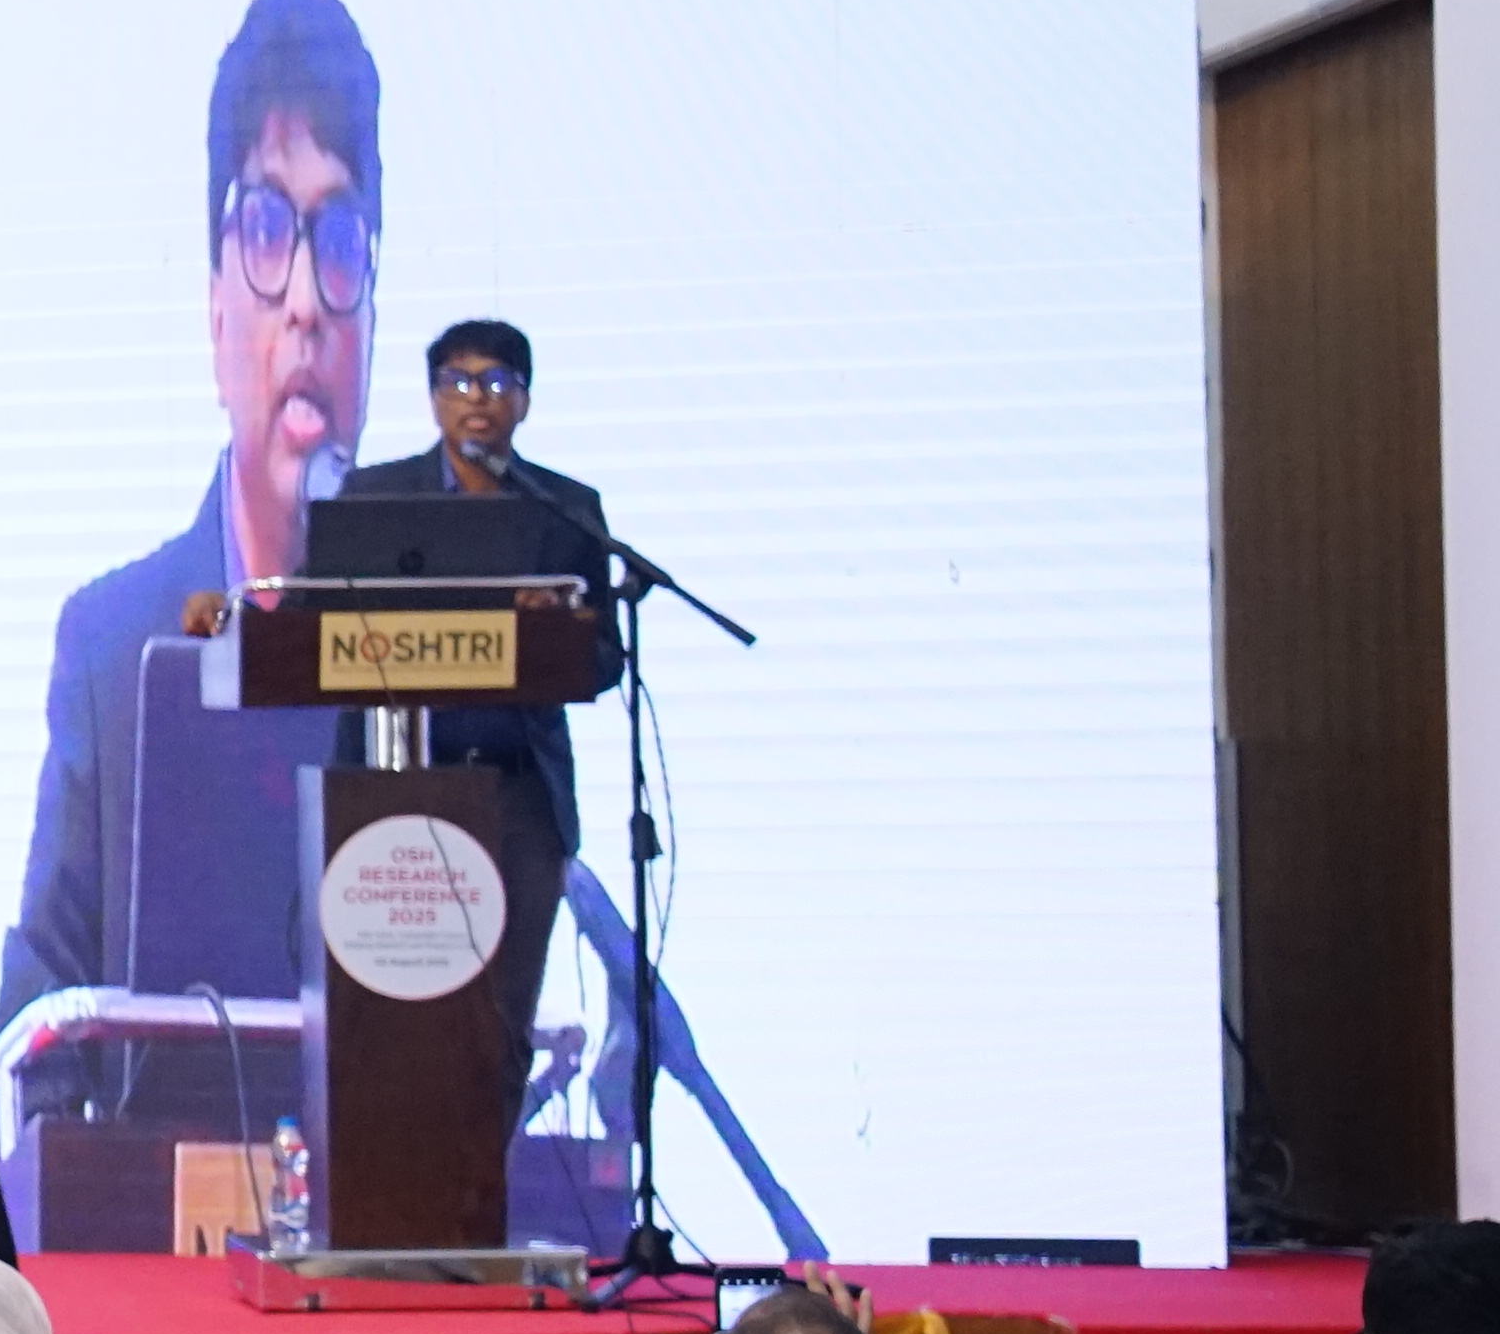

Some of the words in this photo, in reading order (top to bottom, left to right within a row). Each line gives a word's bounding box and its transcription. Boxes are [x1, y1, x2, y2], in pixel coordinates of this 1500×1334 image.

[331, 630, 504, 663] NOSHTRI
[391, 847, 434, 862] OSH
[359, 867, 466, 881] RESEARCH
[343, 889, 481, 903] CONFERENCE
[388, 908, 437, 924] 2025
